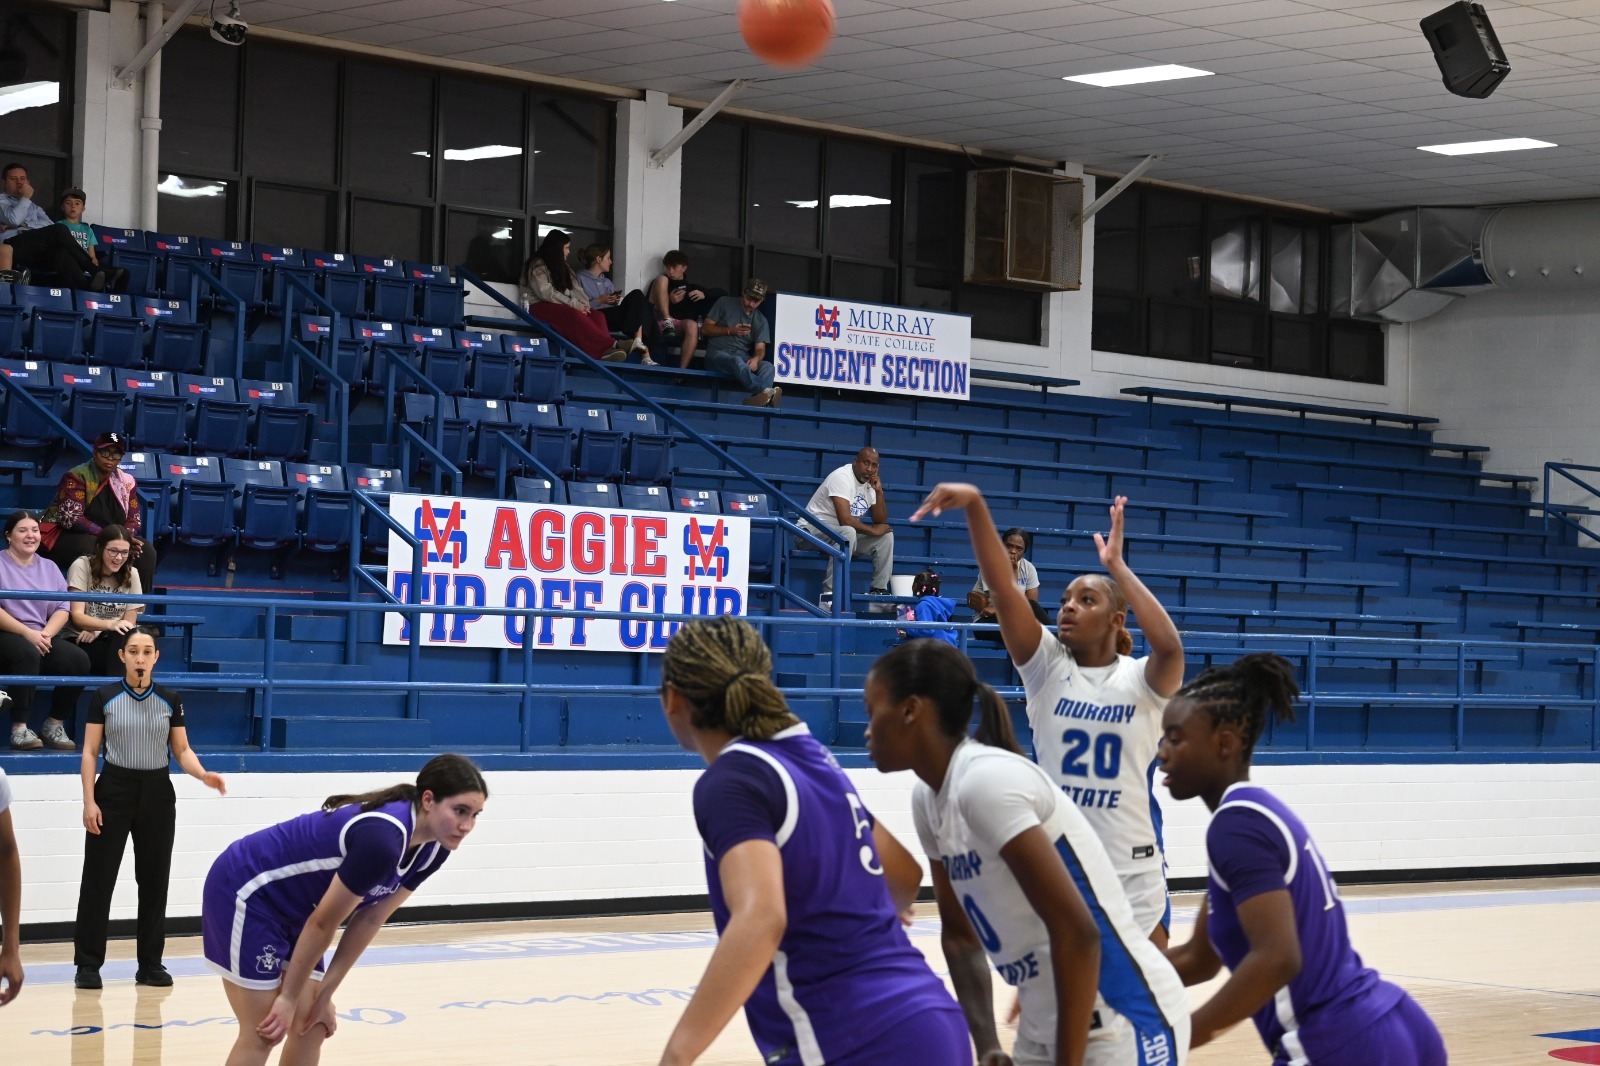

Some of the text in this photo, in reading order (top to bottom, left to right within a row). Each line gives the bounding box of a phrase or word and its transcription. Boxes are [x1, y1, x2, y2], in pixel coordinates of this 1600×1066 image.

[70, 230, 88, 240] AME
[846, 334, 935, 353] STATE COLLEGE
[848, 308, 935, 336] MURRAY
[777, 342, 968, 395] STUDENT SECTION
[484, 506, 668, 578] AGGIE
[392, 571, 486, 643] TIP
[504, 575, 604, 647] OFF
[1053, 697, 1137, 724] MURRAY
[1061, 728, 1123, 780] 20
[845, 792, 884, 875] 5
[1304, 838, 1338, 911] 1
[963, 893, 1001, 954] 0
[996, 951, 1040, 986] ATE
